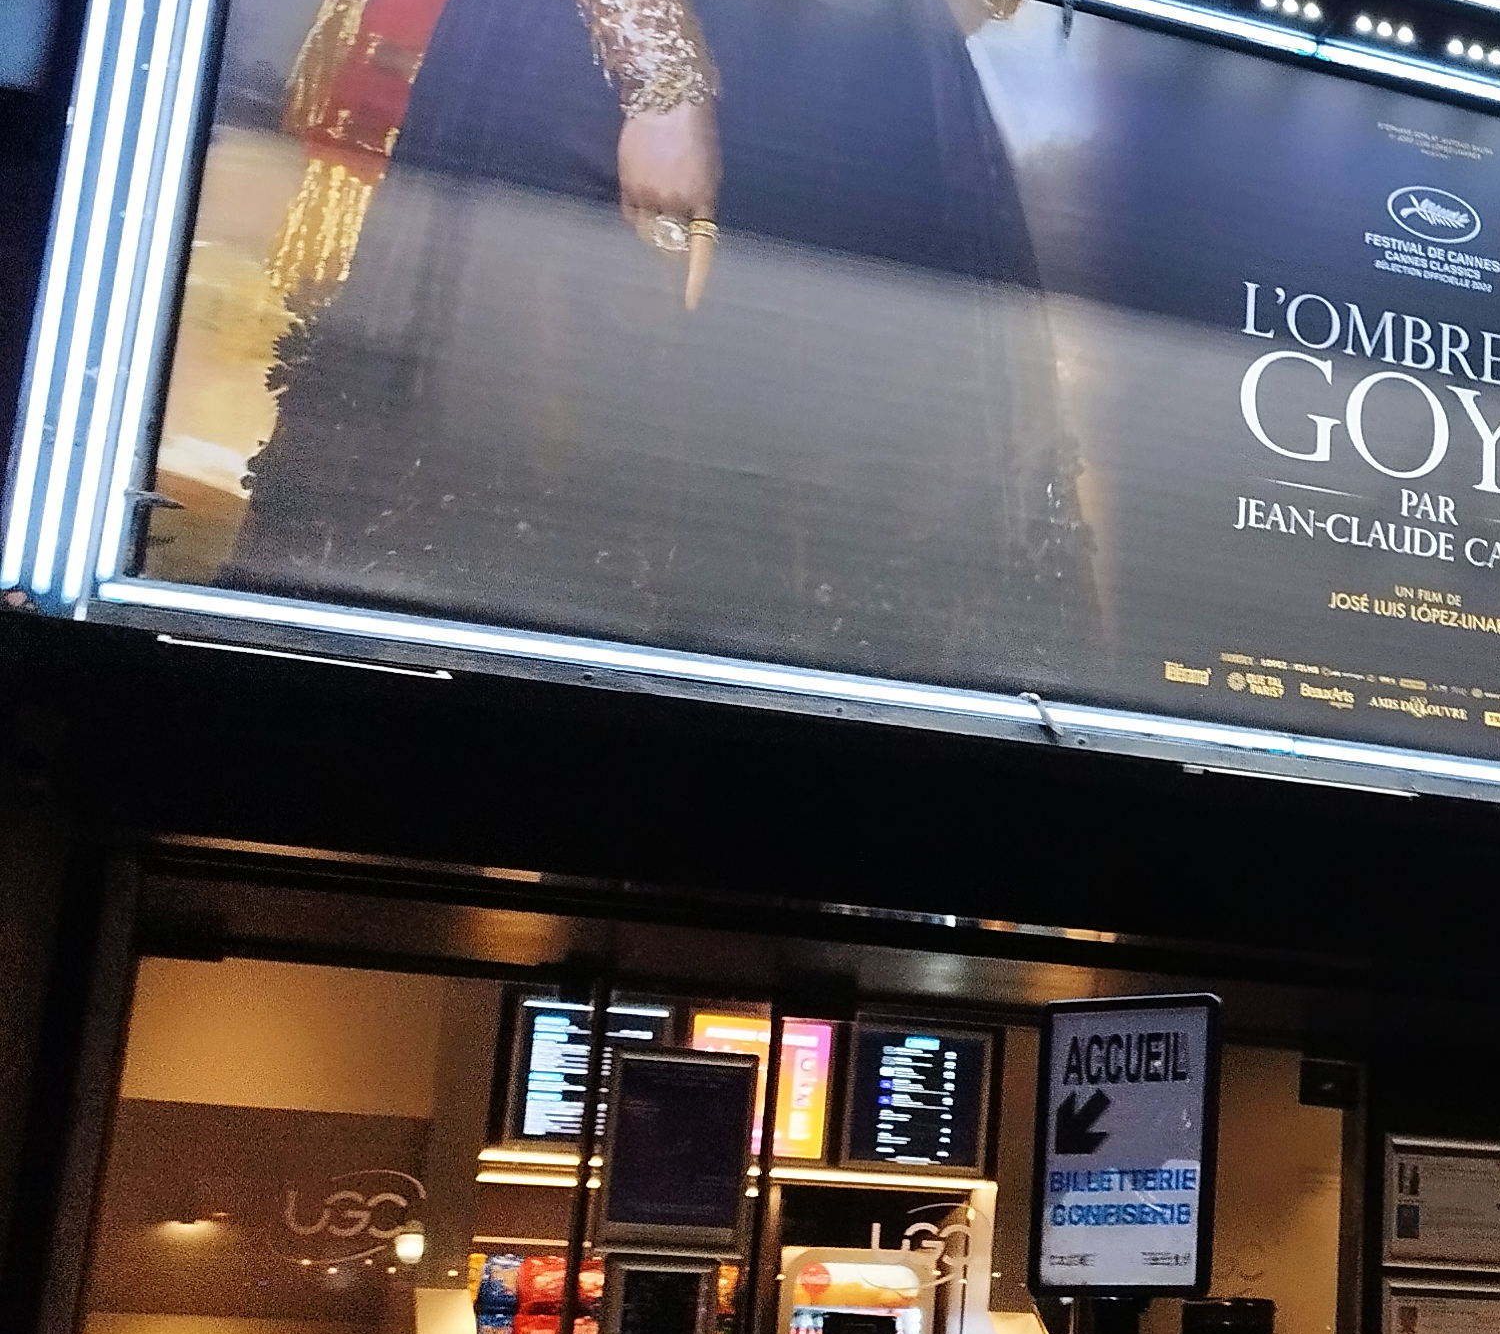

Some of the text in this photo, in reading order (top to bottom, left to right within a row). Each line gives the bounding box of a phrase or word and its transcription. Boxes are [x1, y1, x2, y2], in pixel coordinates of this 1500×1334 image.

[1364, 230, 1426, 258] FESTIVAL
[1426, 244, 1447, 262] DE
[1384, 249, 1482, 281] CANNES CLASSICS
[1400, 488, 1459, 526] PAR
[1232, 496, 1455, 563] JEAN-CLAUDE
[1328, 589, 1370, 615] JOSÉ
[1373, 596, 1407, 620] LUIS
[1394, 584, 1463, 608] UN FILM DE
[1063, 1031, 1188, 1086] ACCUEIL
[1049, 1167, 1197, 1193] BILLETTERIE
[285, 1190, 409, 1239] UGC
